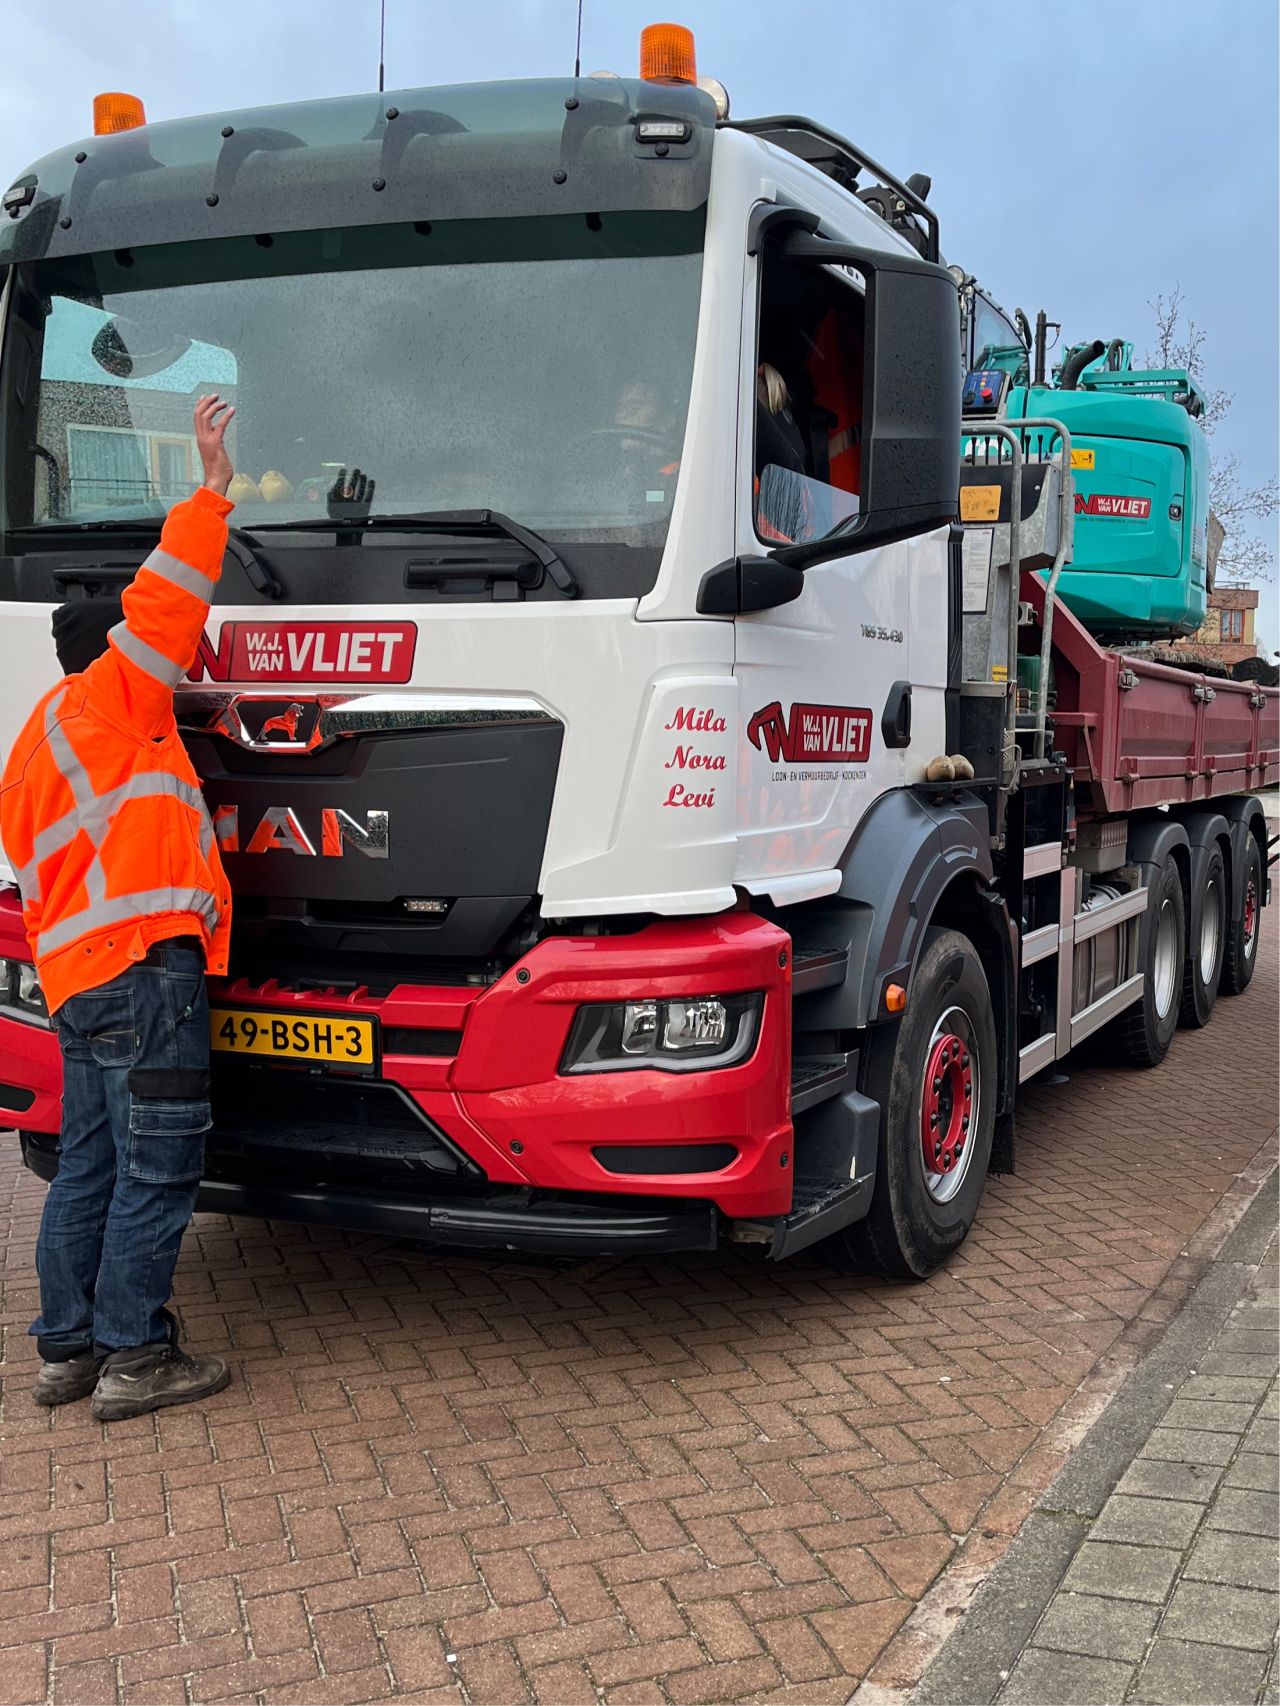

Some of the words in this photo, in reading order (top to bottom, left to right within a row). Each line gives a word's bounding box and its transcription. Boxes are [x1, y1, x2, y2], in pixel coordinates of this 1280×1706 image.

[1111, 498, 1148, 515] VLIET
[245, 632, 283, 651] W.J.
[286, 632, 404, 673] VLIET
[247, 653, 285, 672] VAN
[664, 706, 727, 733] Mila
[802, 714, 821, 733] W.J.
[803, 734, 821, 752] VAN
[822, 715, 868, 753] VLIET
[664, 745, 727, 771] Nora
[790, 771, 799, 782] EN
[799, 770, 839, 781] VERHUURBEDRIJF
[662, 783, 716, 809] Levi
[219, 1016, 363, 1057] 49-BSH-3
